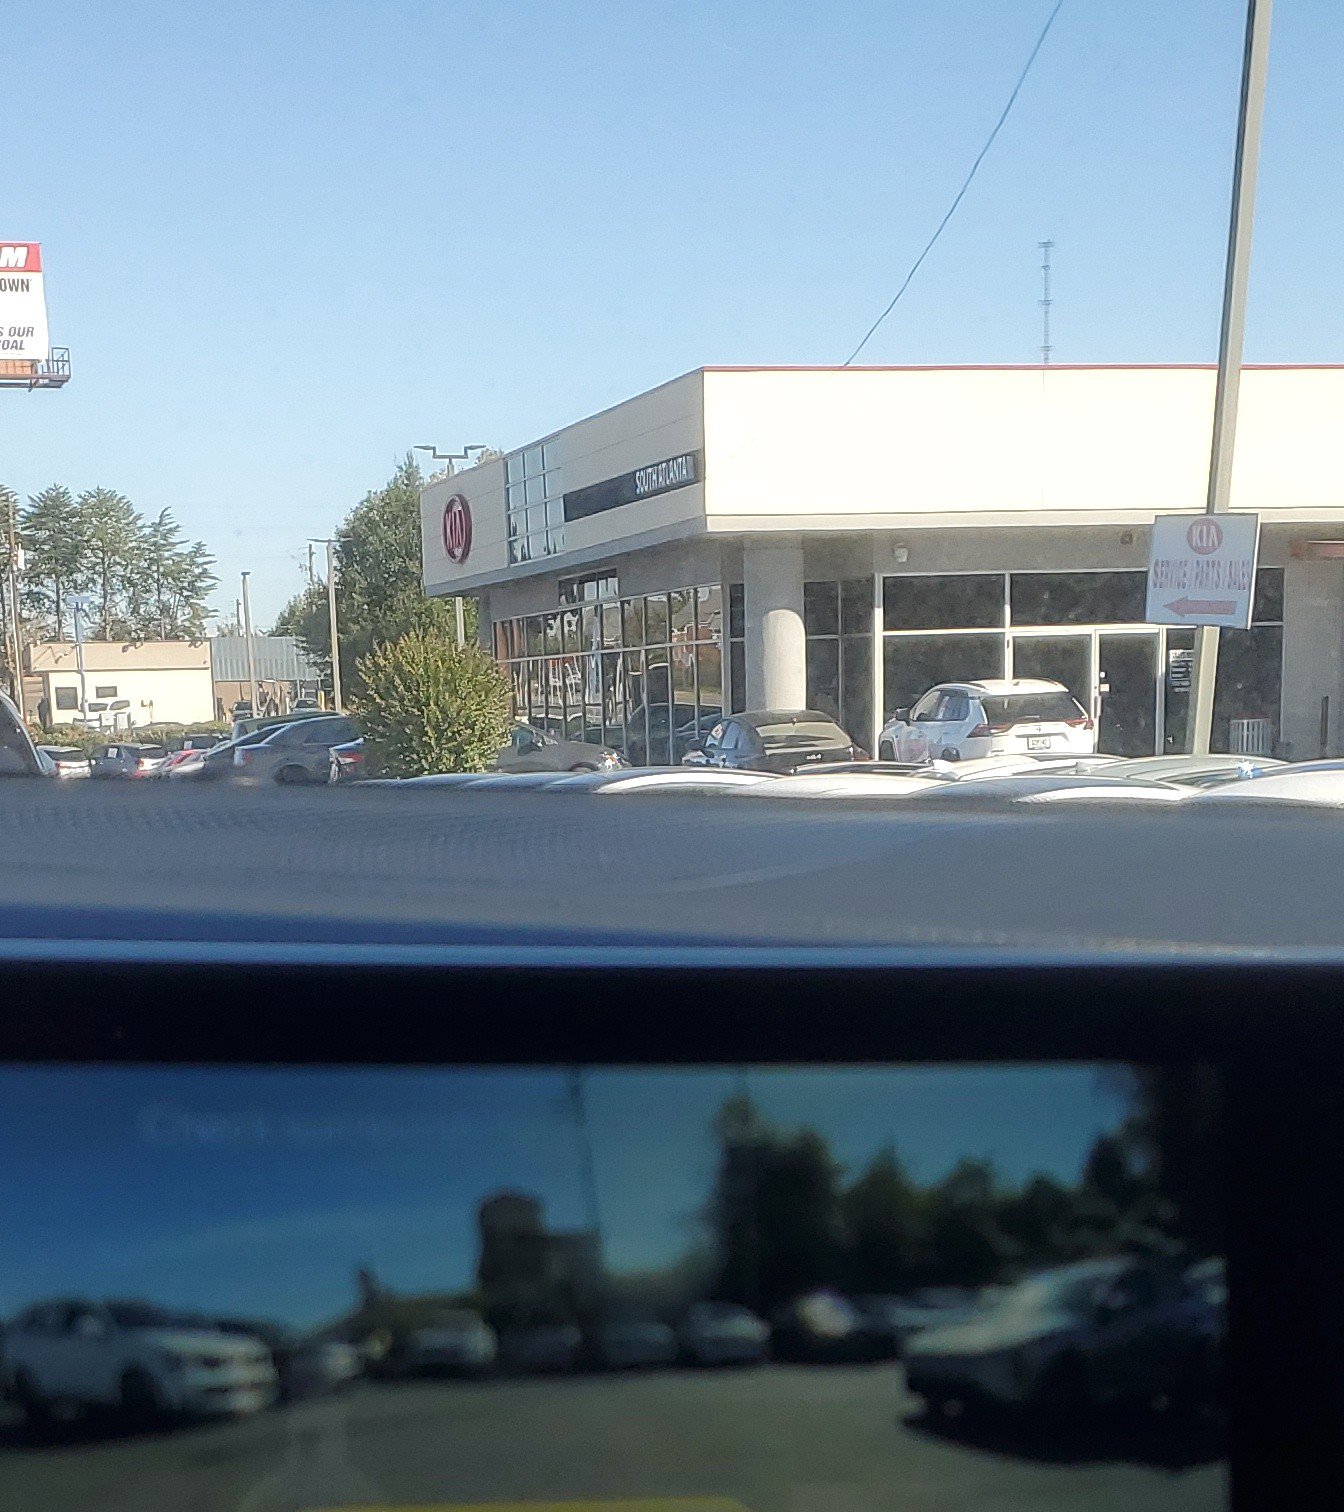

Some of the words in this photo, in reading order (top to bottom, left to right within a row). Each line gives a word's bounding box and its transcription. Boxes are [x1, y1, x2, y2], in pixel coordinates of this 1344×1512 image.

[8, 327, 34, 337] OUR
[636, 467, 658, 494] SOUTH
[658, 456, 687, 488] ATLANTA
[1192, 524, 1219, 547] KIA
